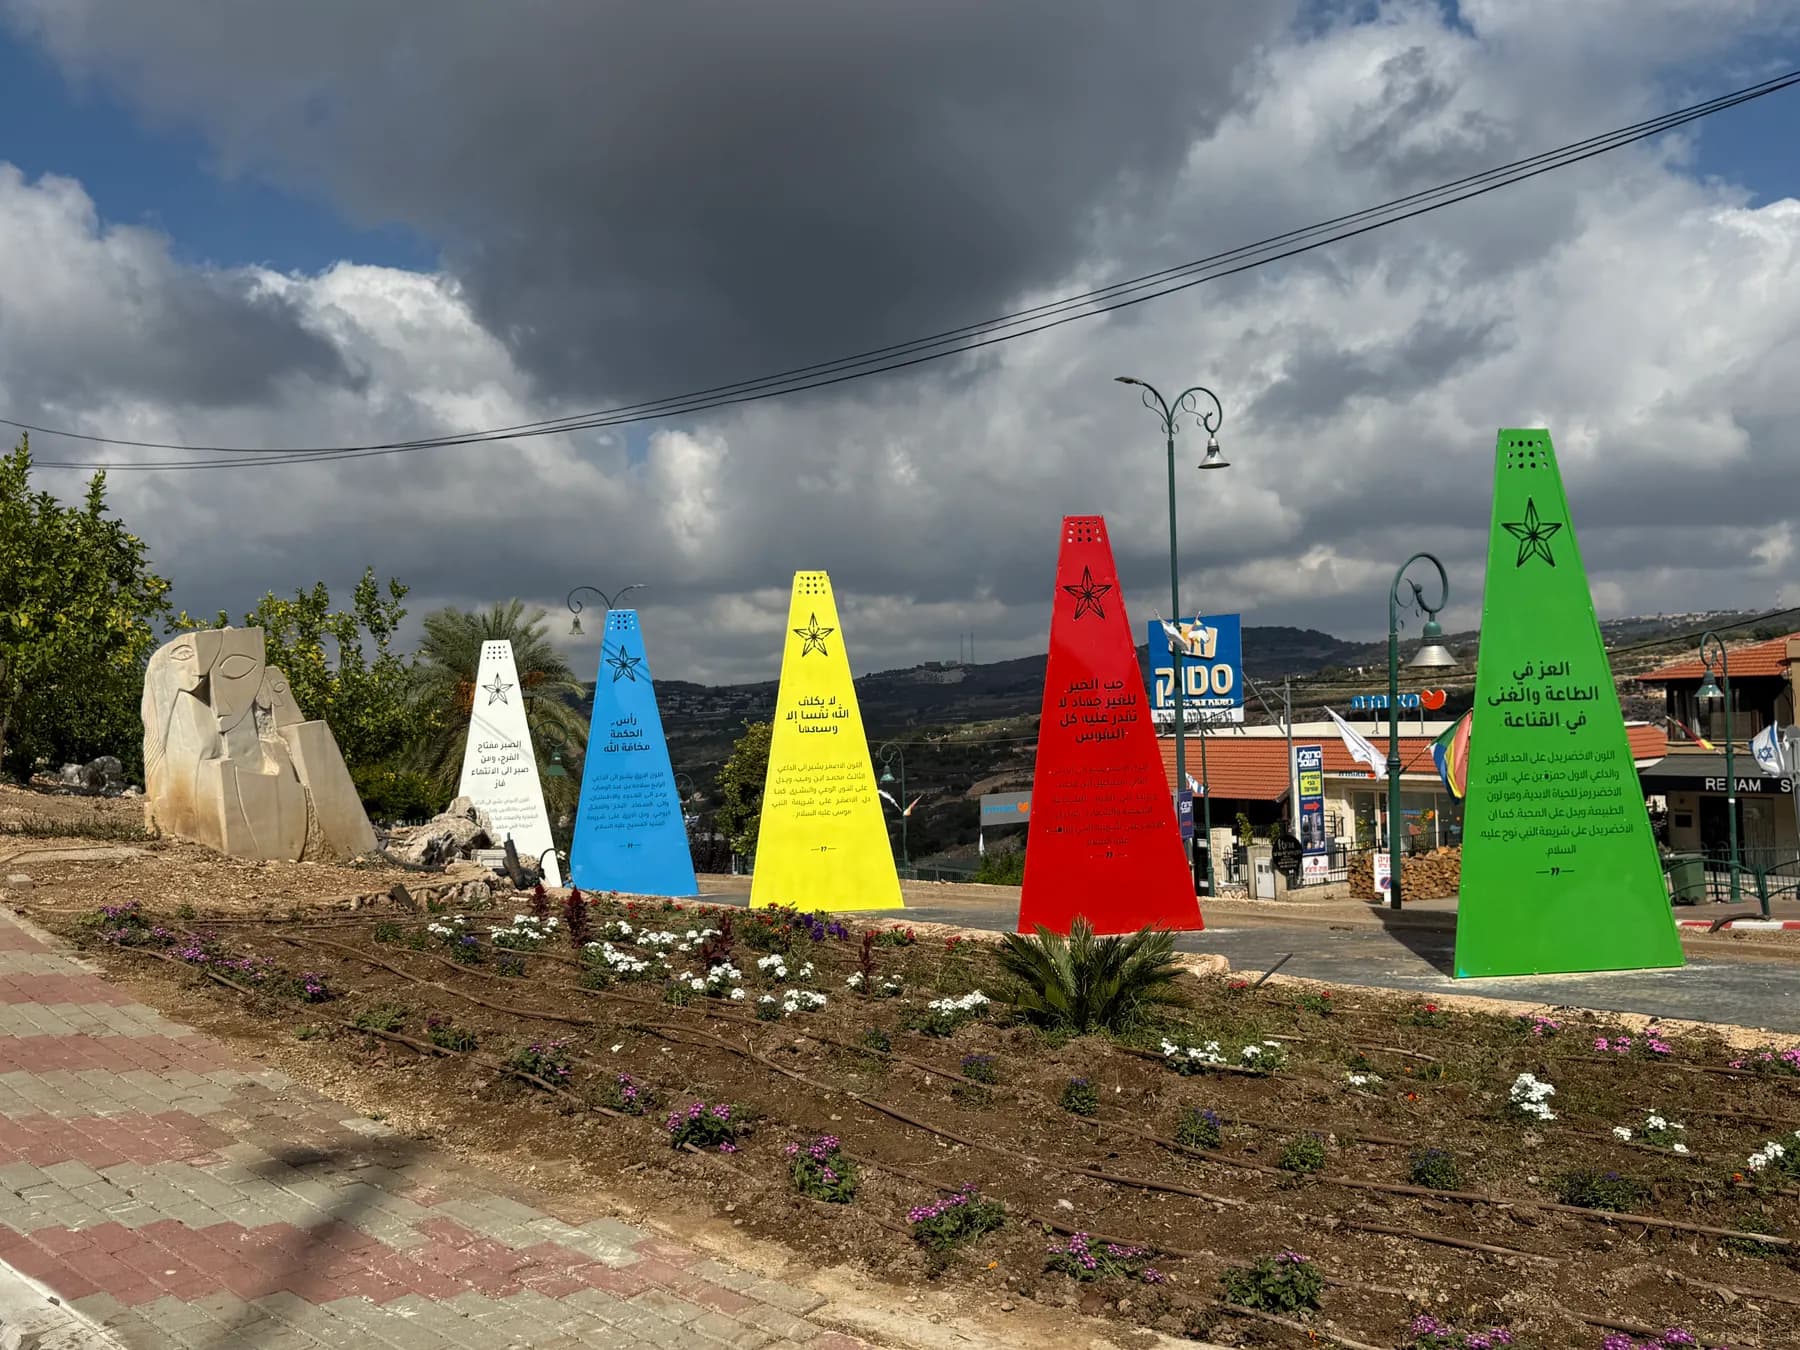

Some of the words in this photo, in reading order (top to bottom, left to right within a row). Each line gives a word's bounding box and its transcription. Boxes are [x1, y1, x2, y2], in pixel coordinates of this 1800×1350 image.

[1512, 661, 1534, 685] في
[1538, 660, 1570, 680] العز
[1068, 678, 1098, 694] الخير
[1104, 680, 1124, 692] حب
[1488, 686, 1540, 706] والغنى
[1546, 685, 1599, 701] الطاعة
[798, 696, 824, 708] يكلف
[828, 696, 836, 706] لا
[1058, 696, 1067, 708] لا
[1105, 692, 1136, 709] للغير
[786, 710, 798, 724] إلا
[802, 708, 828, 720] نفسا
[832, 704, 849, 718] الله
[1060, 713, 1078, 727] كل
[1082, 712, 1108, 726] عليه
[1112, 710, 1138, 726] تقدر
[1504, 712, 1560, 727] القناعة
[1566, 710, 1586, 735] في
[610, 728, 642, 738] الحكمة
[478, 742, 498, 752] مفتاح
[500, 740, 522, 750] الصبر
[604, 740, 619, 752] الله
[622, 742, 650, 752] مخافة
[1486, 754, 1508, 766] الاكبر
[1510, 753, 1528, 762] الحد
[1530, 753, 1546, 764] على
[1548, 752, 1564, 764] يدل
[1594, 750, 1615, 762] اللون
[846, 762, 862, 770] اللون
[1486, 772, 1508, 784] اللون
[1532, 772, 1542, 782] بن
[1568, 770, 1587, 782] الاول
[1590, 768, 1620, 783] والداعي
[494, 779, 506, 789] فاز
[1486, 791, 1502, 802] لون
[1552, 788, 1578, 800] للحياة
[1578, 788, 1594, 800] رمز
[1594, 786, 1622, 799] الاخضر
[1548, 808, 1564, 819] على
[1480, 830, 1500, 838] عليه
[1502, 830, 1518, 842] نوح
[1519, 828, 1540, 840] النبي
[1540, 826, 1570, 838] شريعة
[1571, 826, 1588, 838] على
[1589, 826, 1604, 838] يدل
[1604, 824, 1634, 836] الاخضر
